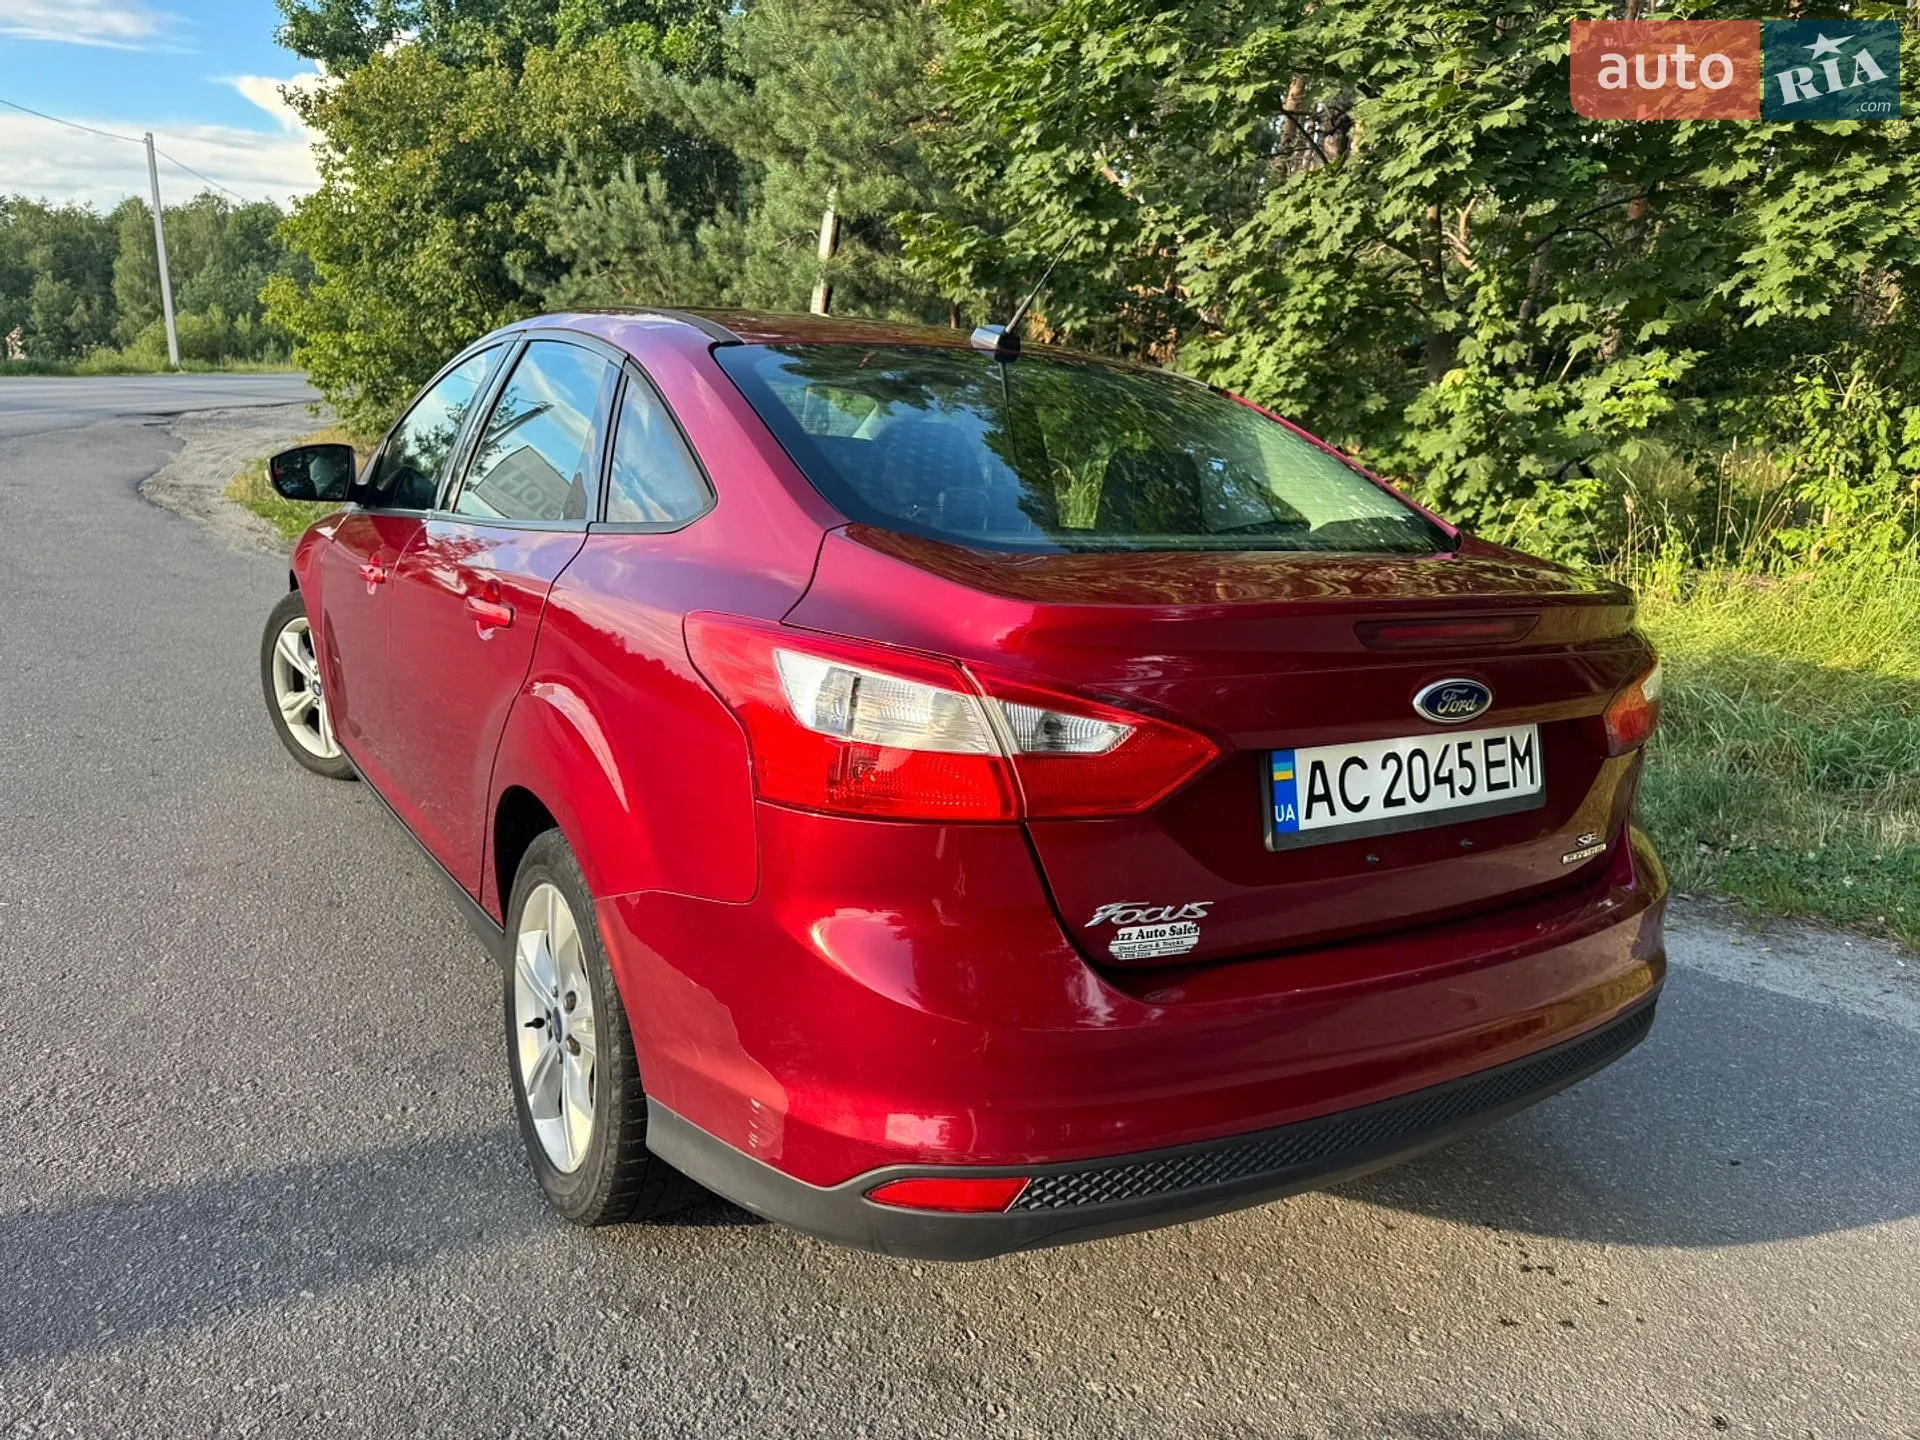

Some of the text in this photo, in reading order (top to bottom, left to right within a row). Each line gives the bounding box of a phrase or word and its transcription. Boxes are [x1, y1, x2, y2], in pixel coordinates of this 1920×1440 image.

[1437, 688, 1479, 714] Ford
[1304, 732, 1536, 820] AC 2045 EM
[1274, 802, 1296, 823] UA
[1135, 928, 1167, 940] Auto
[1168, 924, 1199, 936] Sales
